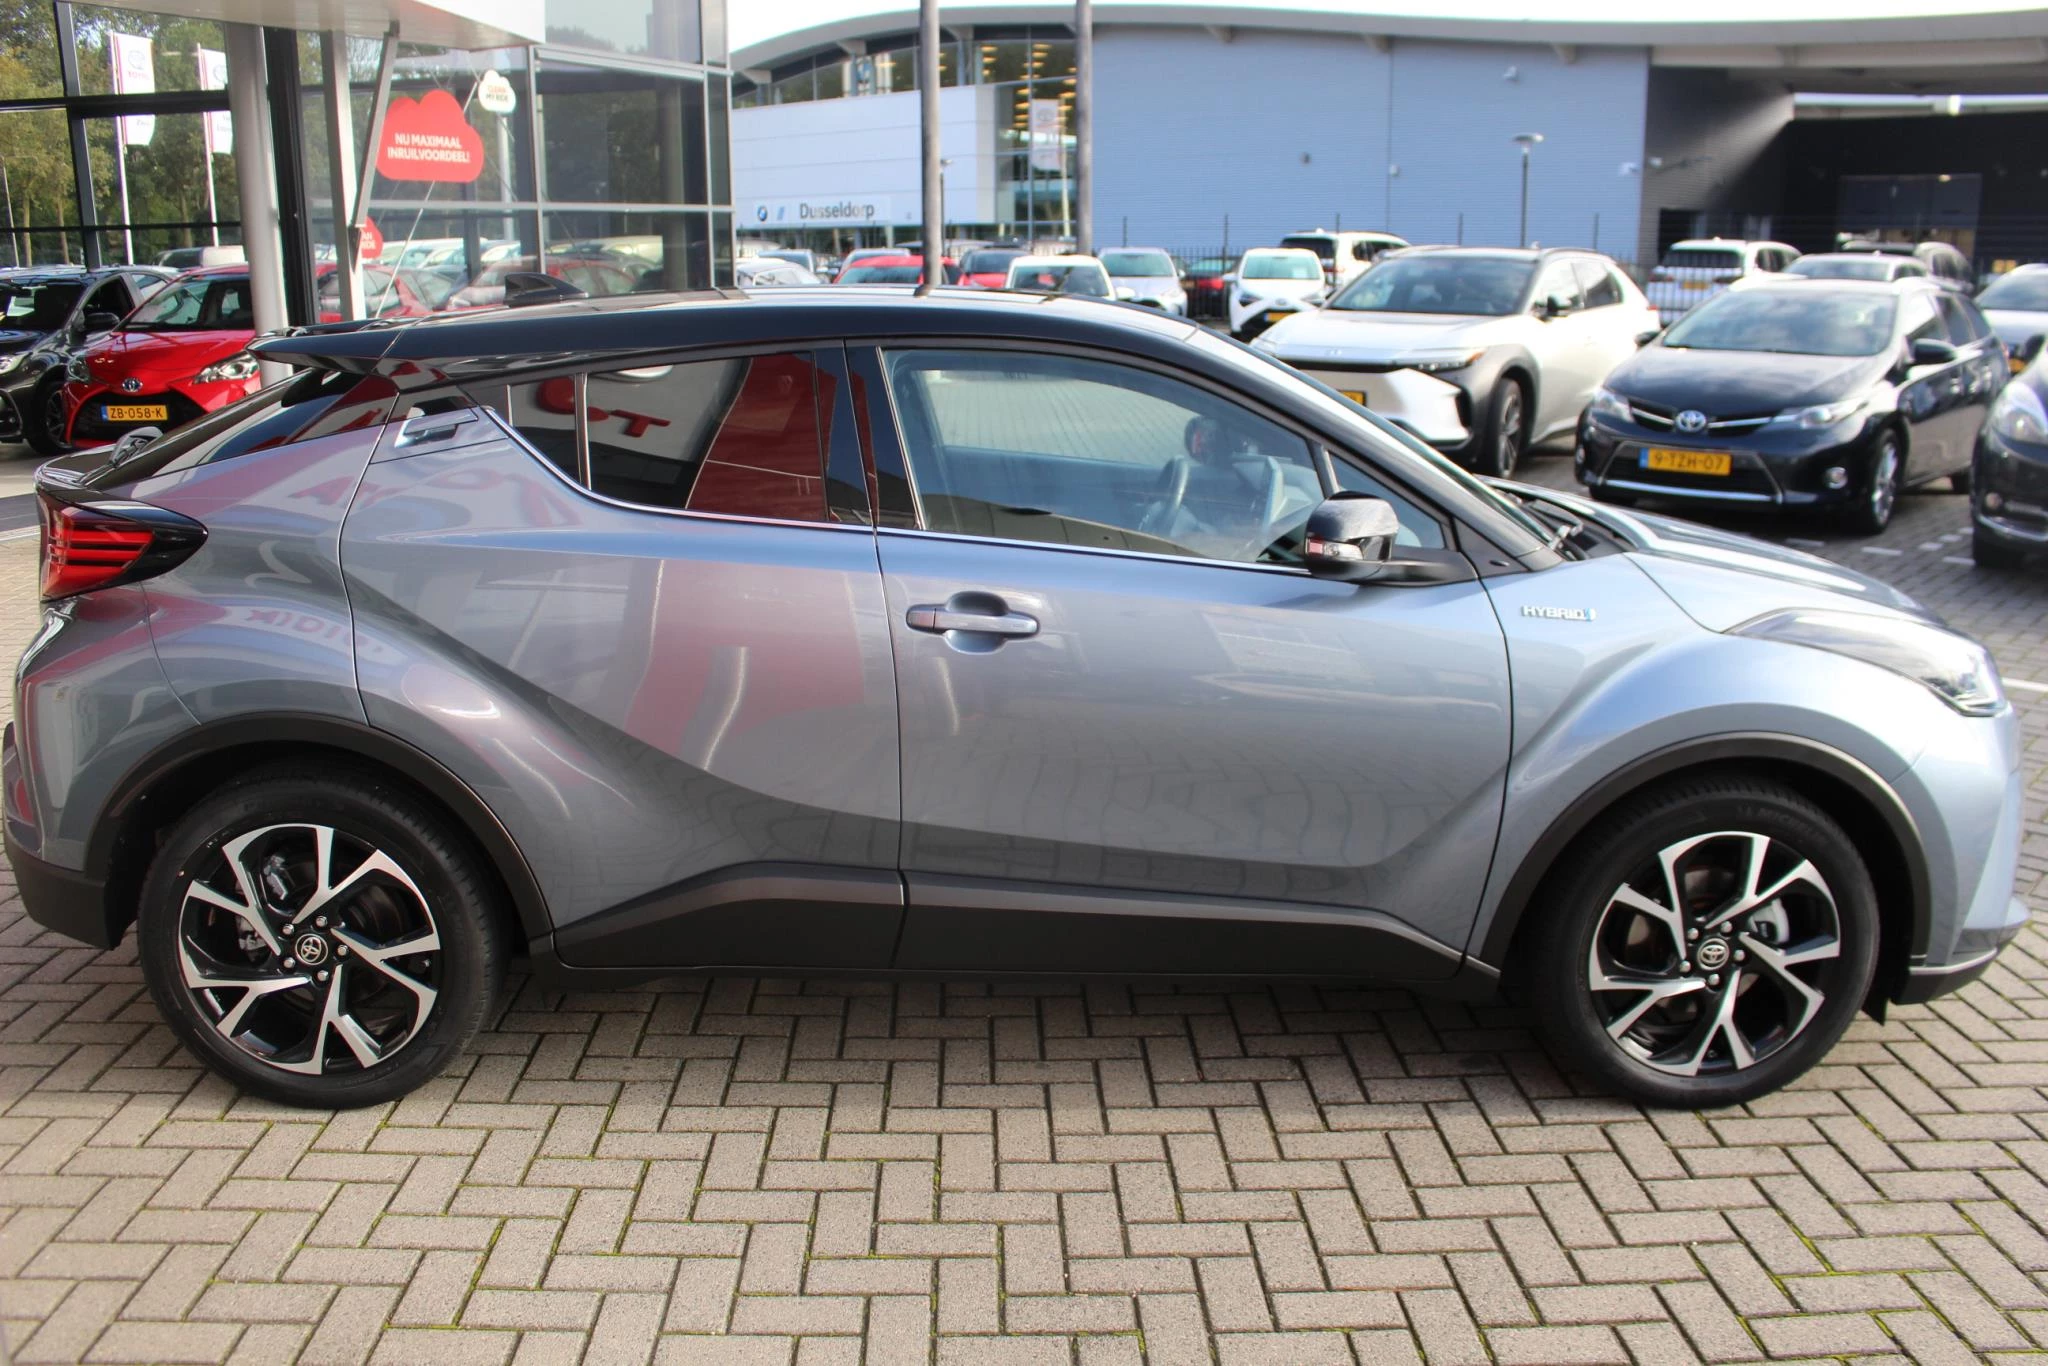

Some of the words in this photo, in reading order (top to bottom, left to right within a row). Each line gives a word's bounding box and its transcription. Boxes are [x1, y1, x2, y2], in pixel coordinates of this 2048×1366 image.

[394, 132, 410, 146] NU
[411, 134, 462, 149] MAXIMAAL
[800, 202, 875, 219] Dusseldorp
[109, 407, 164, 419] ZB-058-K
[1520, 605, 1586, 621] HYBRID
